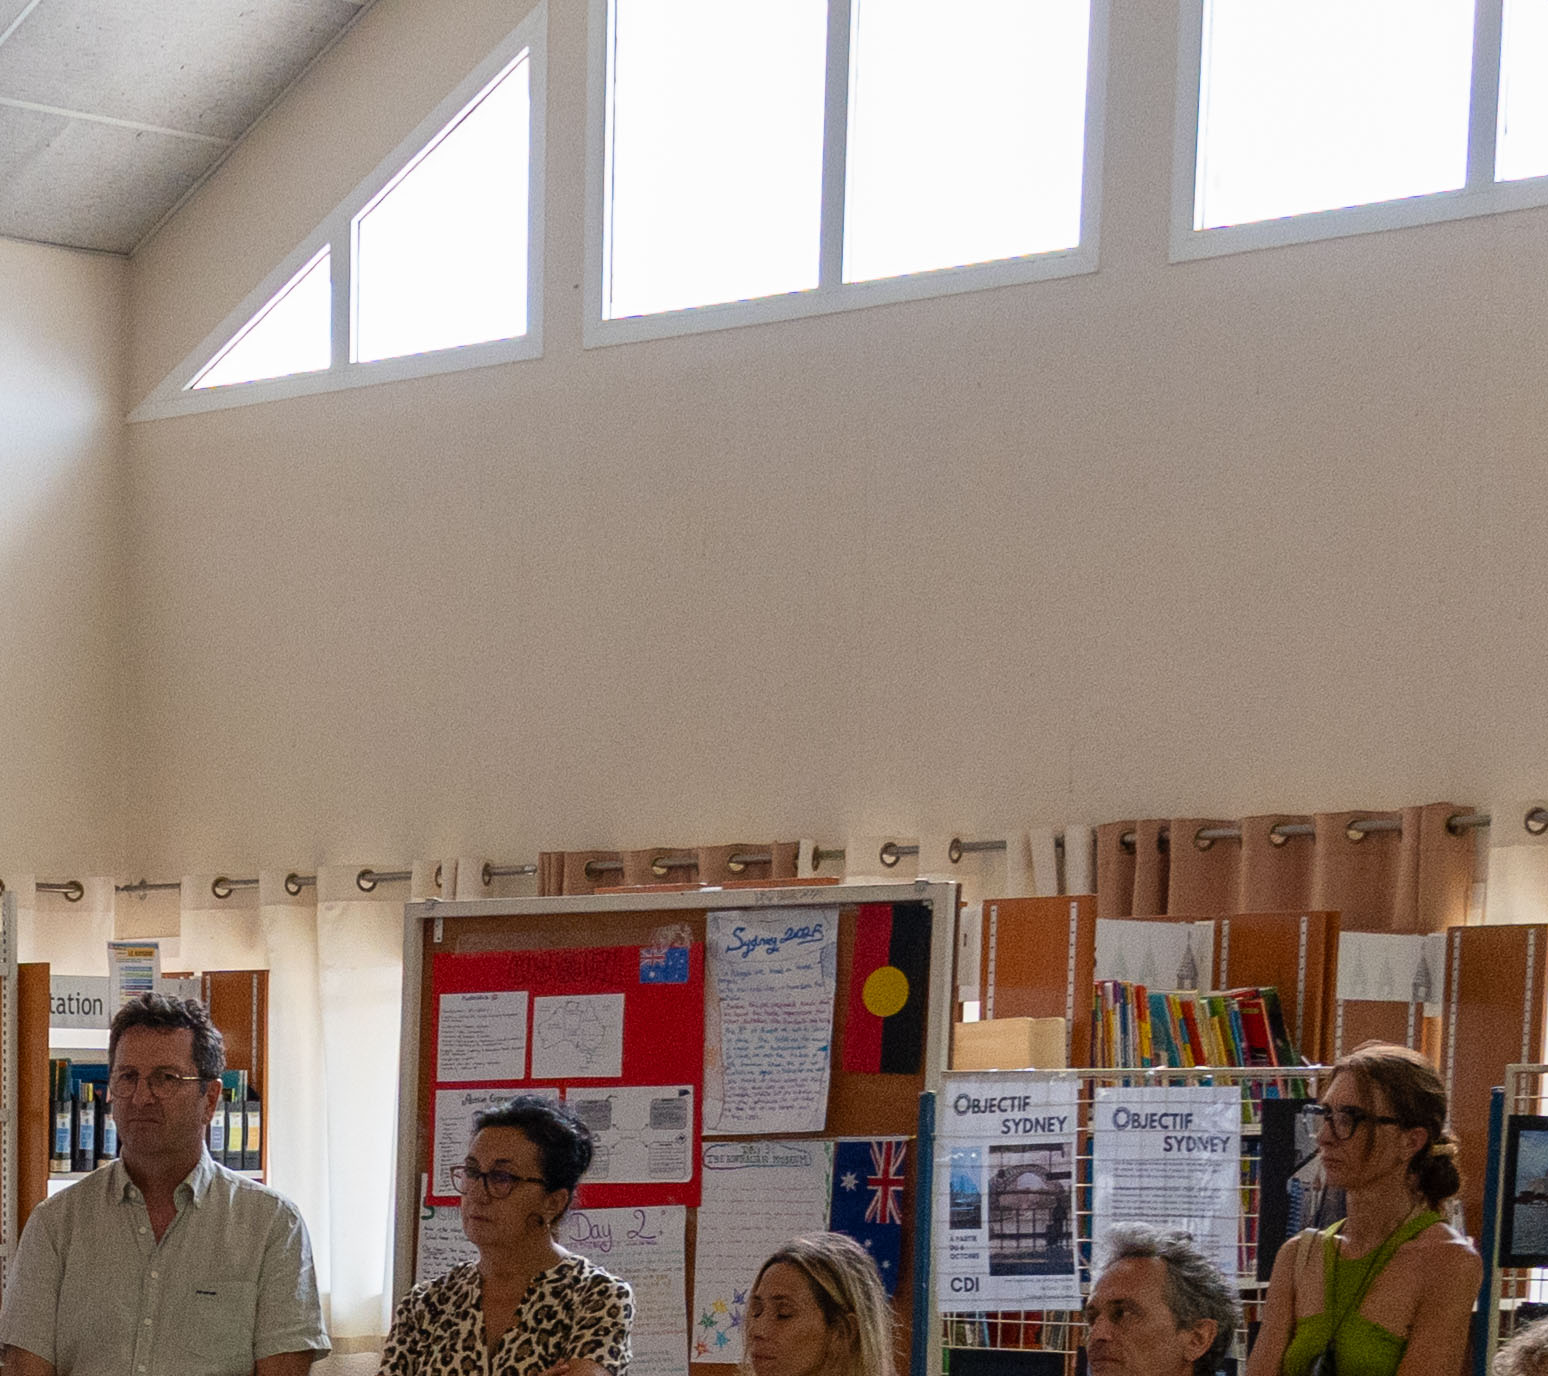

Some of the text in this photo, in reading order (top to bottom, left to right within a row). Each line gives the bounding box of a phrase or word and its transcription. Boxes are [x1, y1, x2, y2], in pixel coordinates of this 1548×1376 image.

[725, 926, 780, 958] Sydney
[954, 1093, 1031, 1116] OBJECTIF
[1001, 1116, 1068, 1134] SYDNEY
[1113, 1106, 1194, 1131] OBJECTIF
[1163, 1136, 1231, 1153] SYDNEY
[569, 1212, 612, 1252] Day
[950, 1277, 980, 1293] CDI
